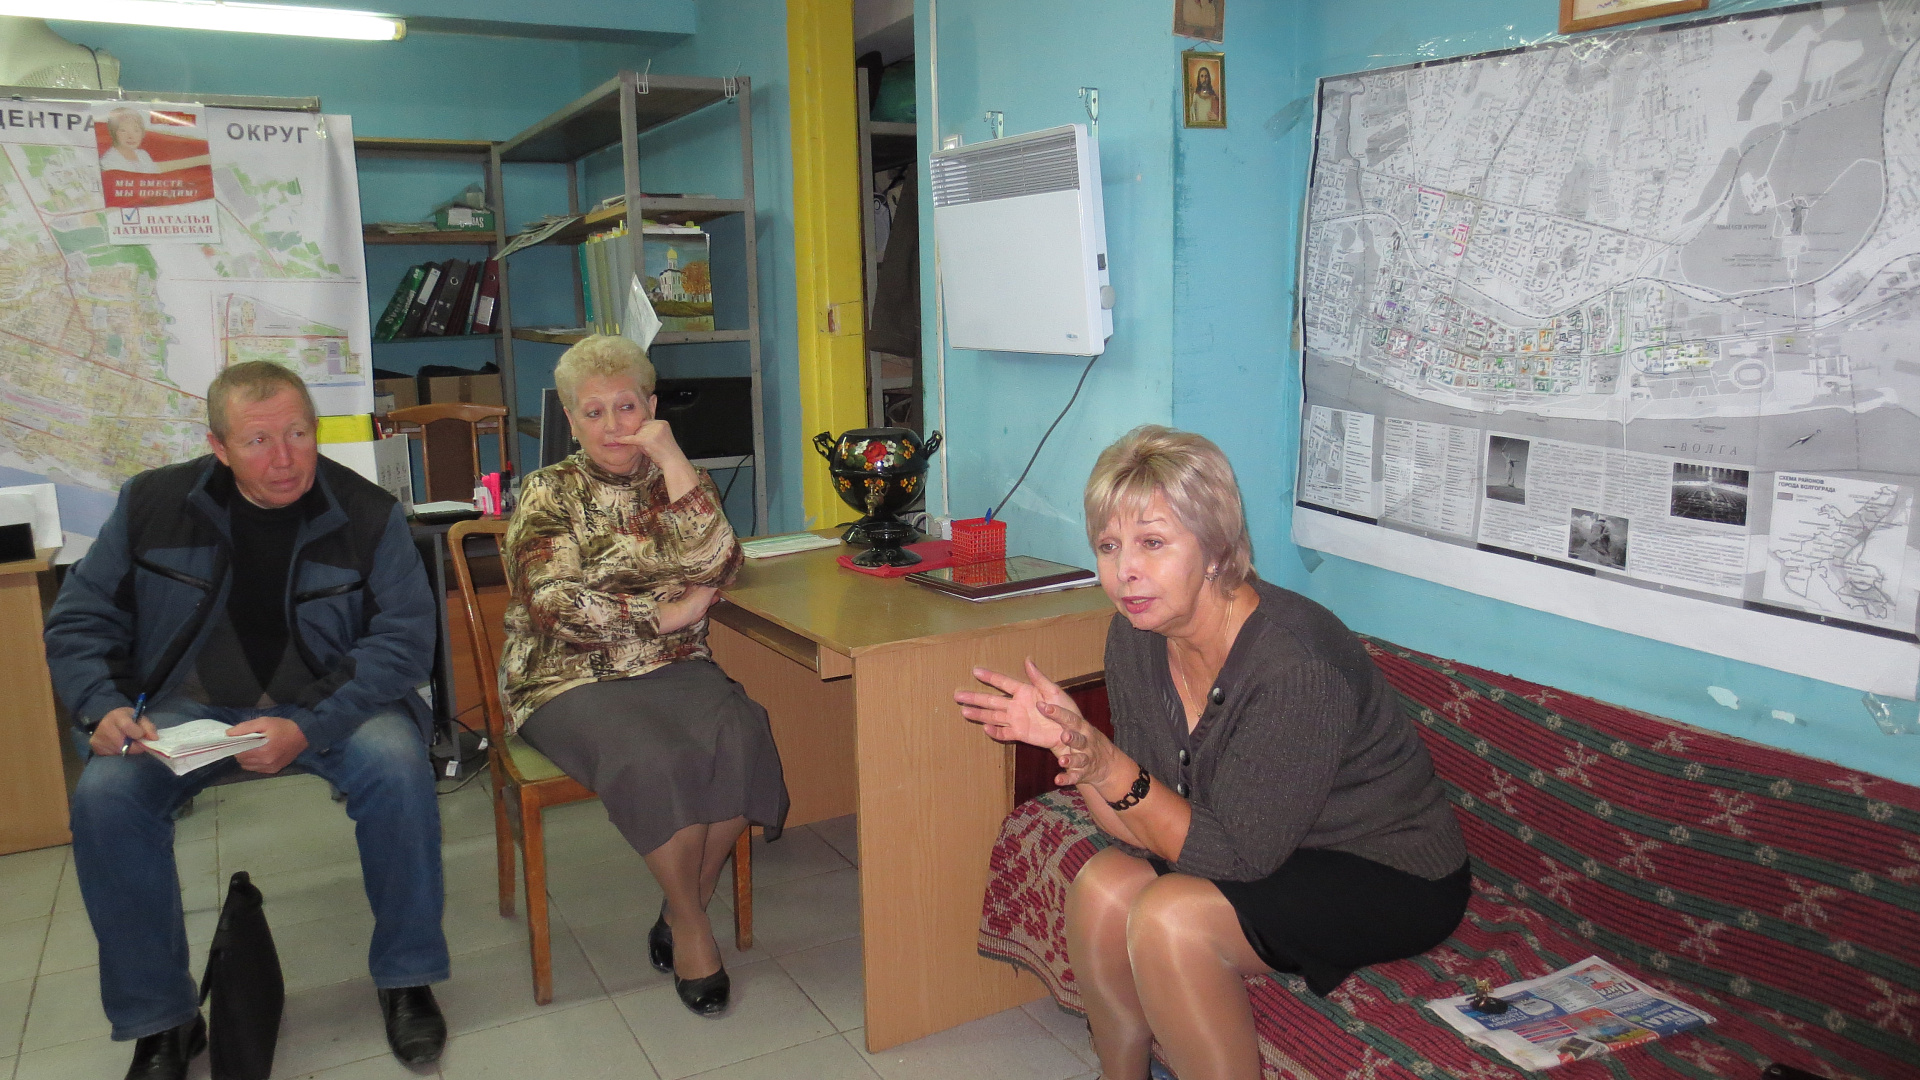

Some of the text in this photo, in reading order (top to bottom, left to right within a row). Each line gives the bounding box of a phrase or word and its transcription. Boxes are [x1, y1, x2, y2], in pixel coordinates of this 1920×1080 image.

[227, 123, 309, 143] ОКРУГ
[115, 179, 134, 188] МЫ
[139, 179, 184, 188] ВМЕСТЕ
[114, 189, 198, 198] МЫ ПОБЕДИМ!
[147, 215, 210, 225] НАТАЛЬЯ
[113, 225, 213, 235] ЛАТЫШЕВСКАЯ
[1680, 442, 1738, 456] ВОЛГА
[1800, 484, 1836, 493] ВОЛГОГРАДА
